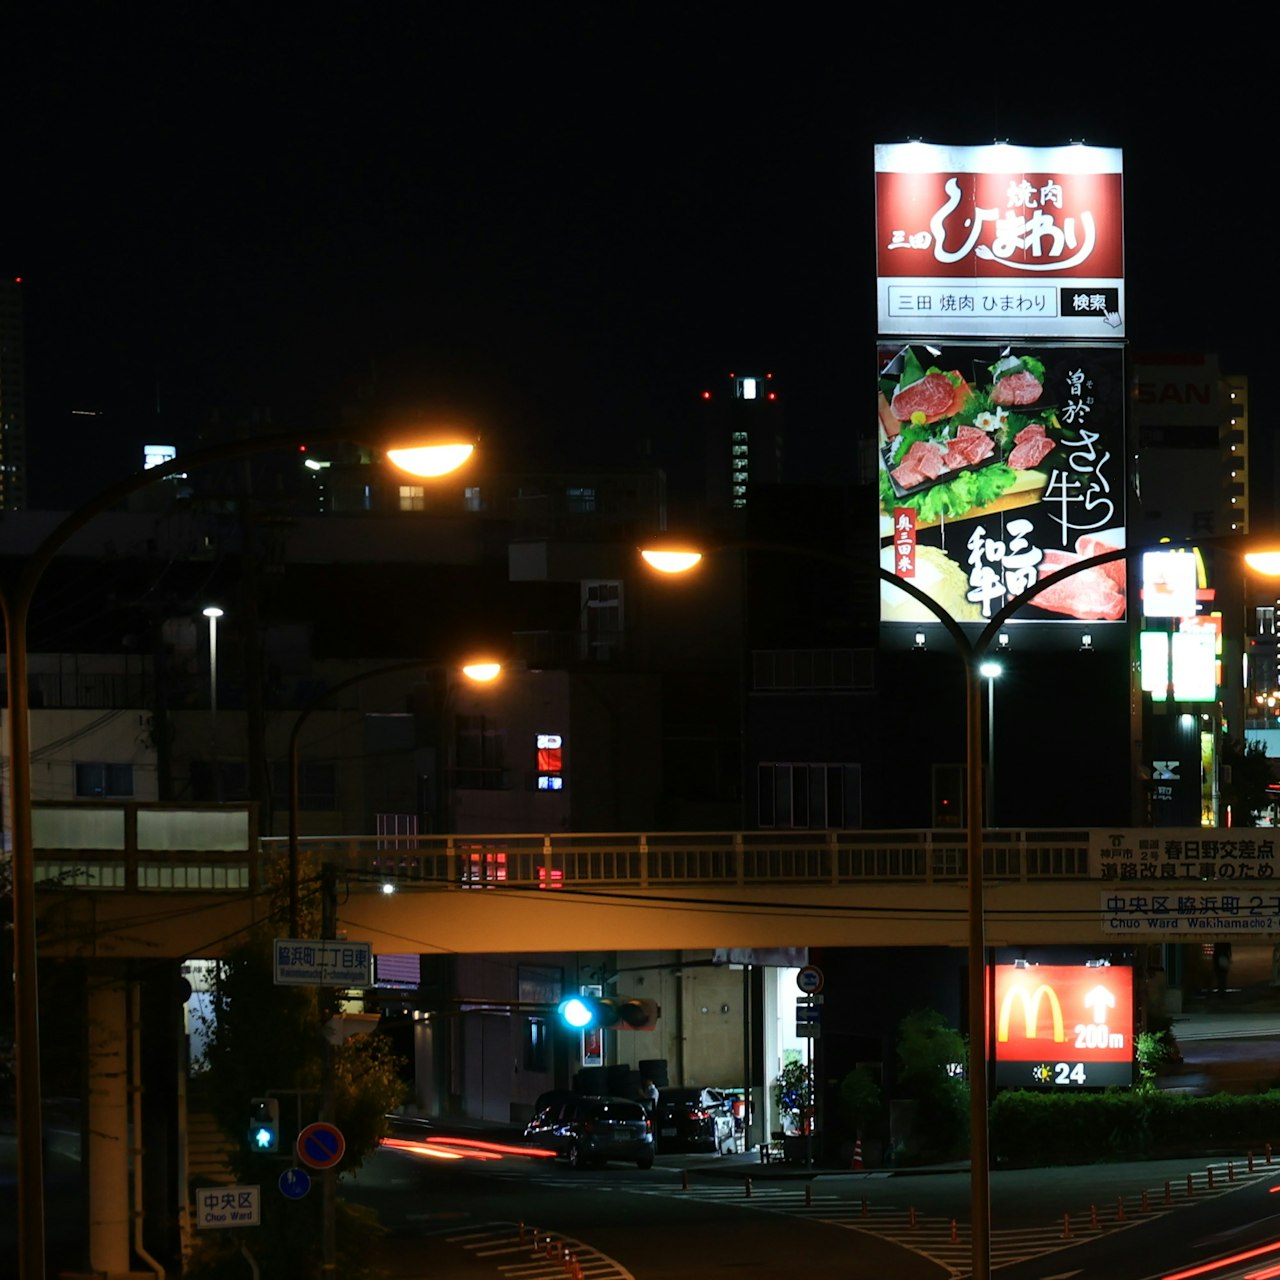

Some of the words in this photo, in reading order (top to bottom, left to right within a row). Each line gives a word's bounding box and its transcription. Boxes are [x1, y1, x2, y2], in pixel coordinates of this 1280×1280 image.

[1006, 180, 1063, 208] 焼肉
[887, 229, 933, 250] 三田
[930, 177, 1097, 271] ひまわり
[898, 295, 932, 311] 三田
[939, 294, 975, 312] 焼肉
[982, 294, 1047, 312] ひまわり
[1072, 294, 1106, 312] 検索
[895, 513, 914, 573] 奥三田米
[1165, 840, 1274, 860] 春日野交差点
[1101, 862, 1275, 879] 道路改良工事のため
[1107, 897, 1170, 915] 中央区
[1110, 918, 1140, 928] Chuo
[1148, 918, 1178, 928] Ward
[1074, 1024, 1124, 1049] 200m
[1054, 1063, 1086, 1085] 24
[204, 1192, 252, 1210] 中央区
